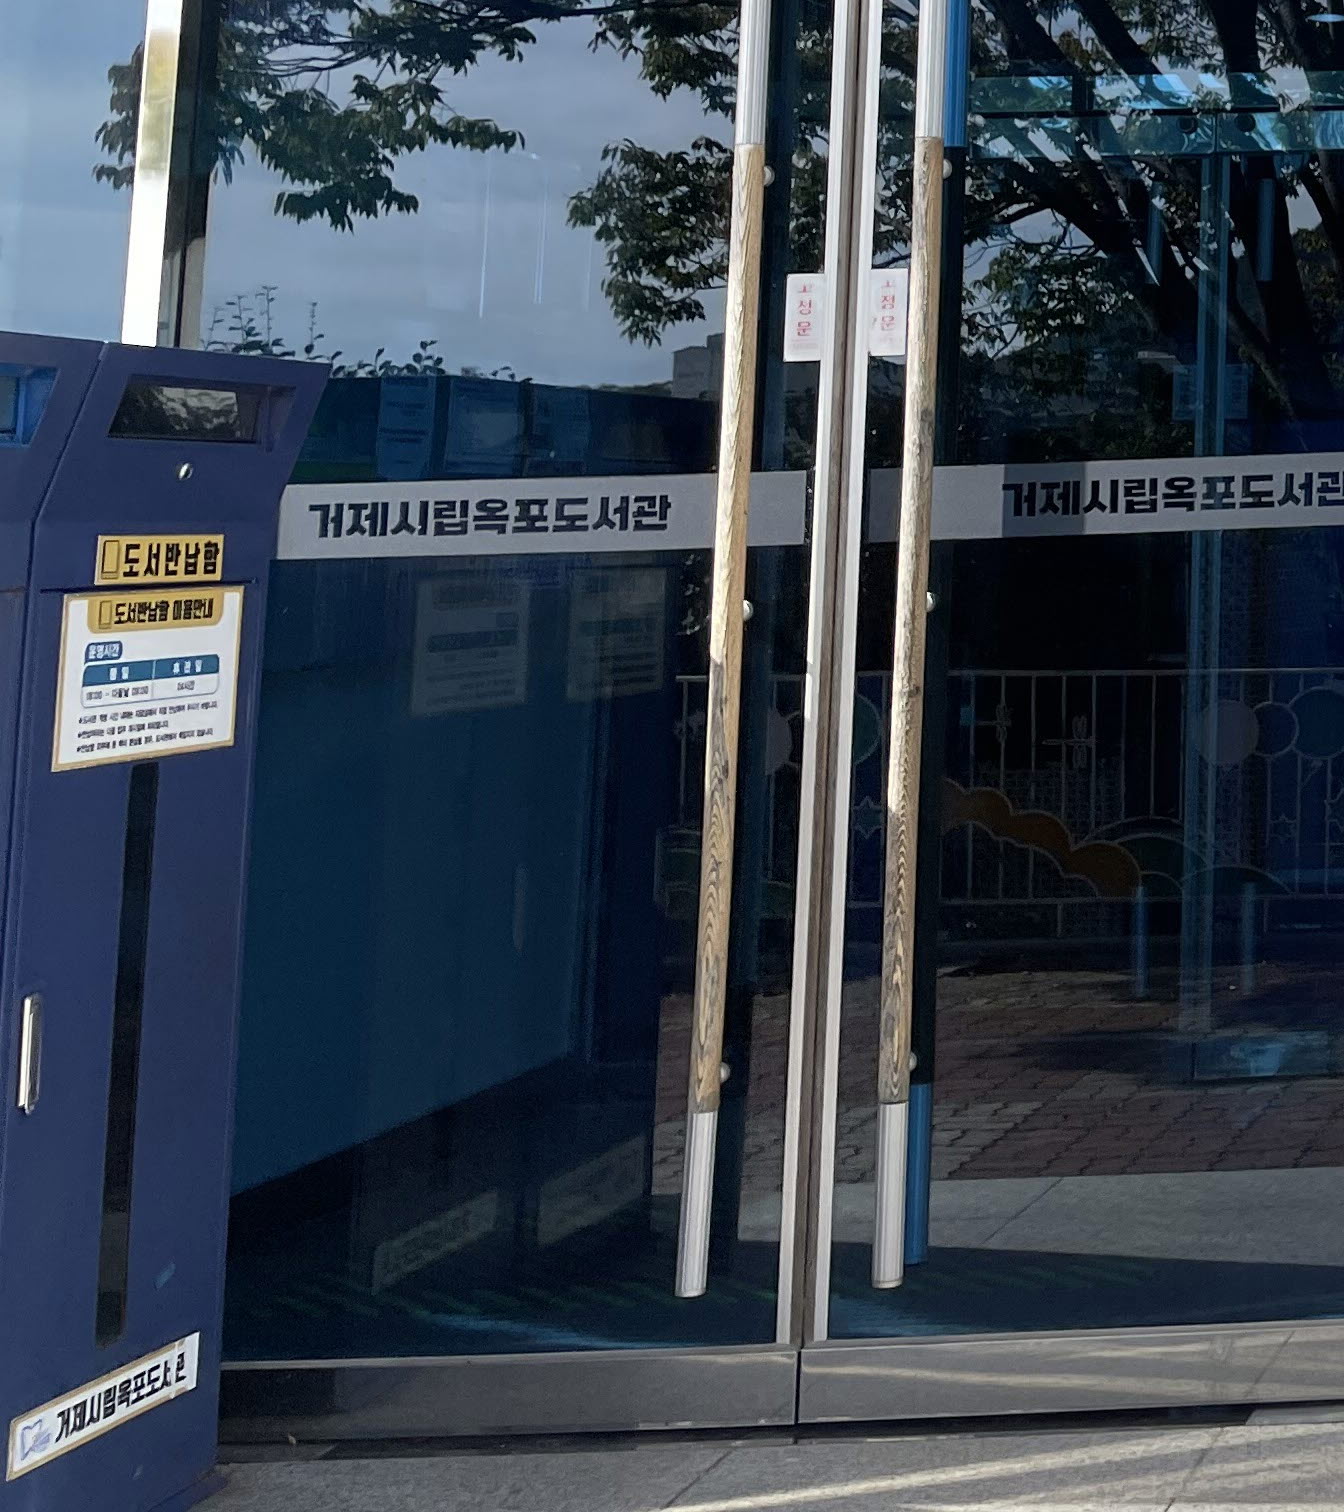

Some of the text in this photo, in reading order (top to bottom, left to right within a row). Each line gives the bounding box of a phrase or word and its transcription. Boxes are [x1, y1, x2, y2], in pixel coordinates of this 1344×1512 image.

[309, 494, 672, 538] 거제시립옥포도서관
[122, 540, 220, 578] 도서반납함
[114, 597, 215, 625] 도서반납함 이용안내
